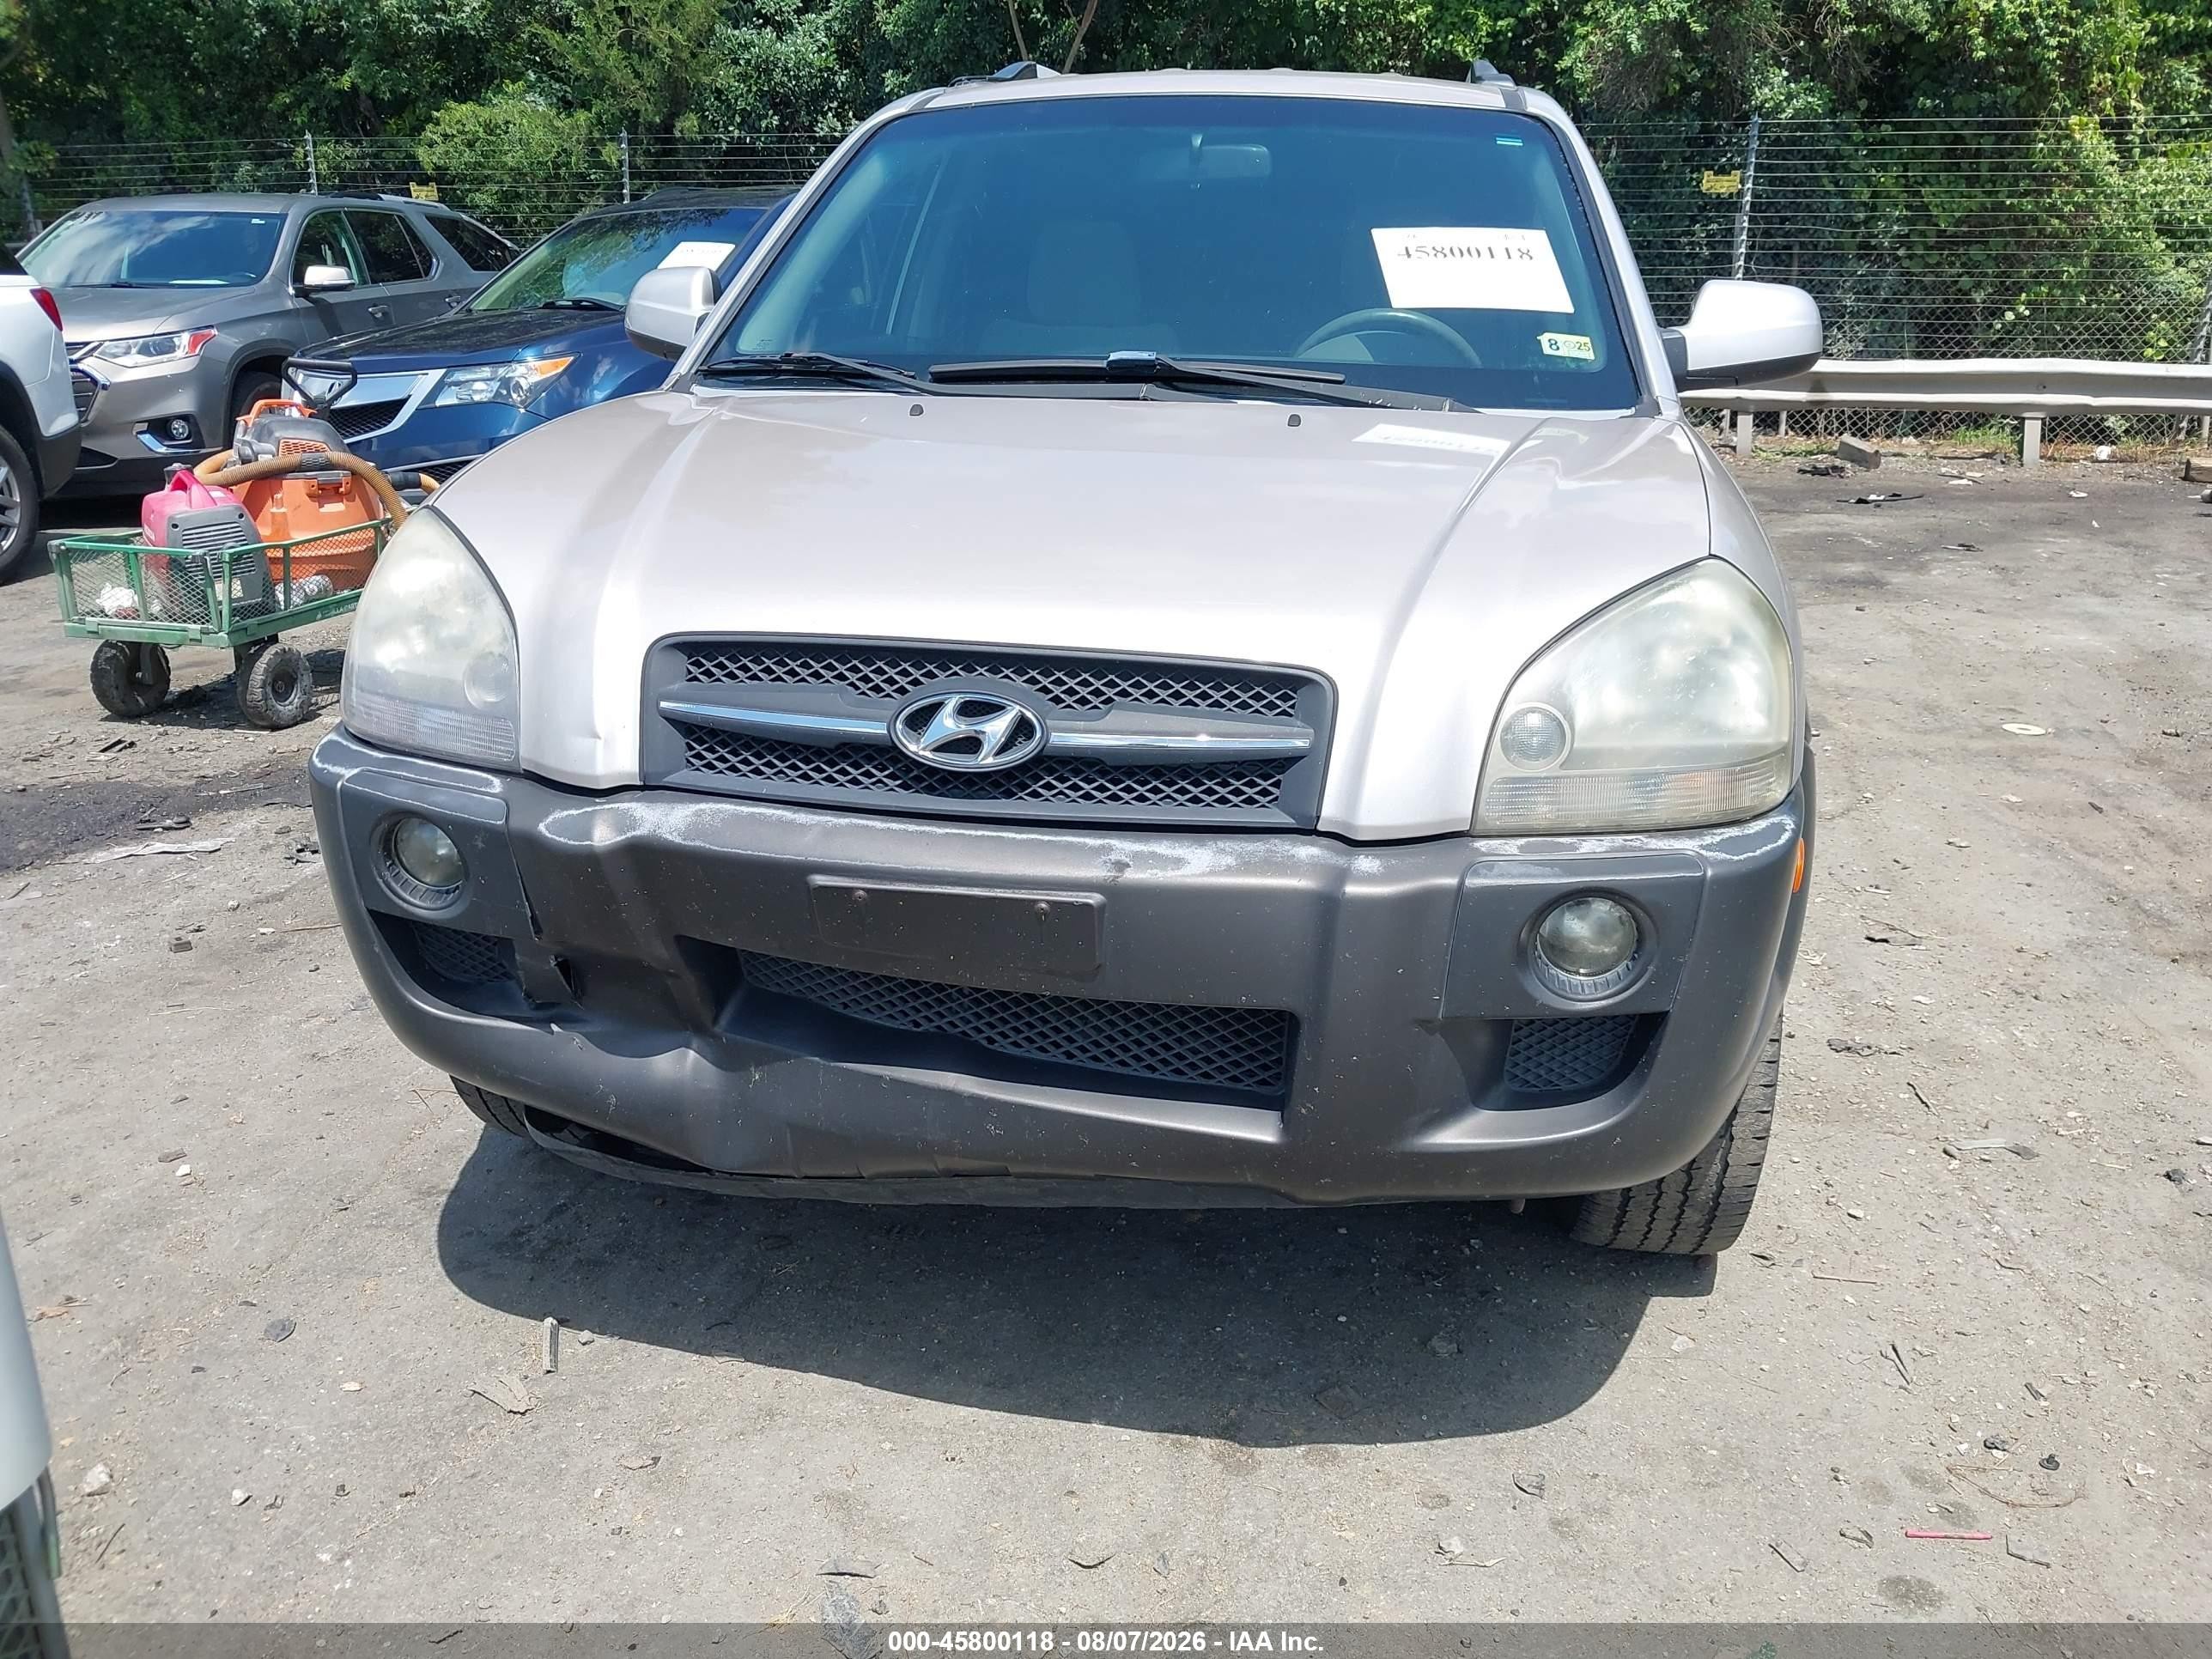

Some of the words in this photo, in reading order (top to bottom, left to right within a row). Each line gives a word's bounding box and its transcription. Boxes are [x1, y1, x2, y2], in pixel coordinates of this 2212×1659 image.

[1397, 246, 1534, 261] 45800118
[1547, 338, 1560, 351] 8
[1576, 341, 1591, 352] 25
